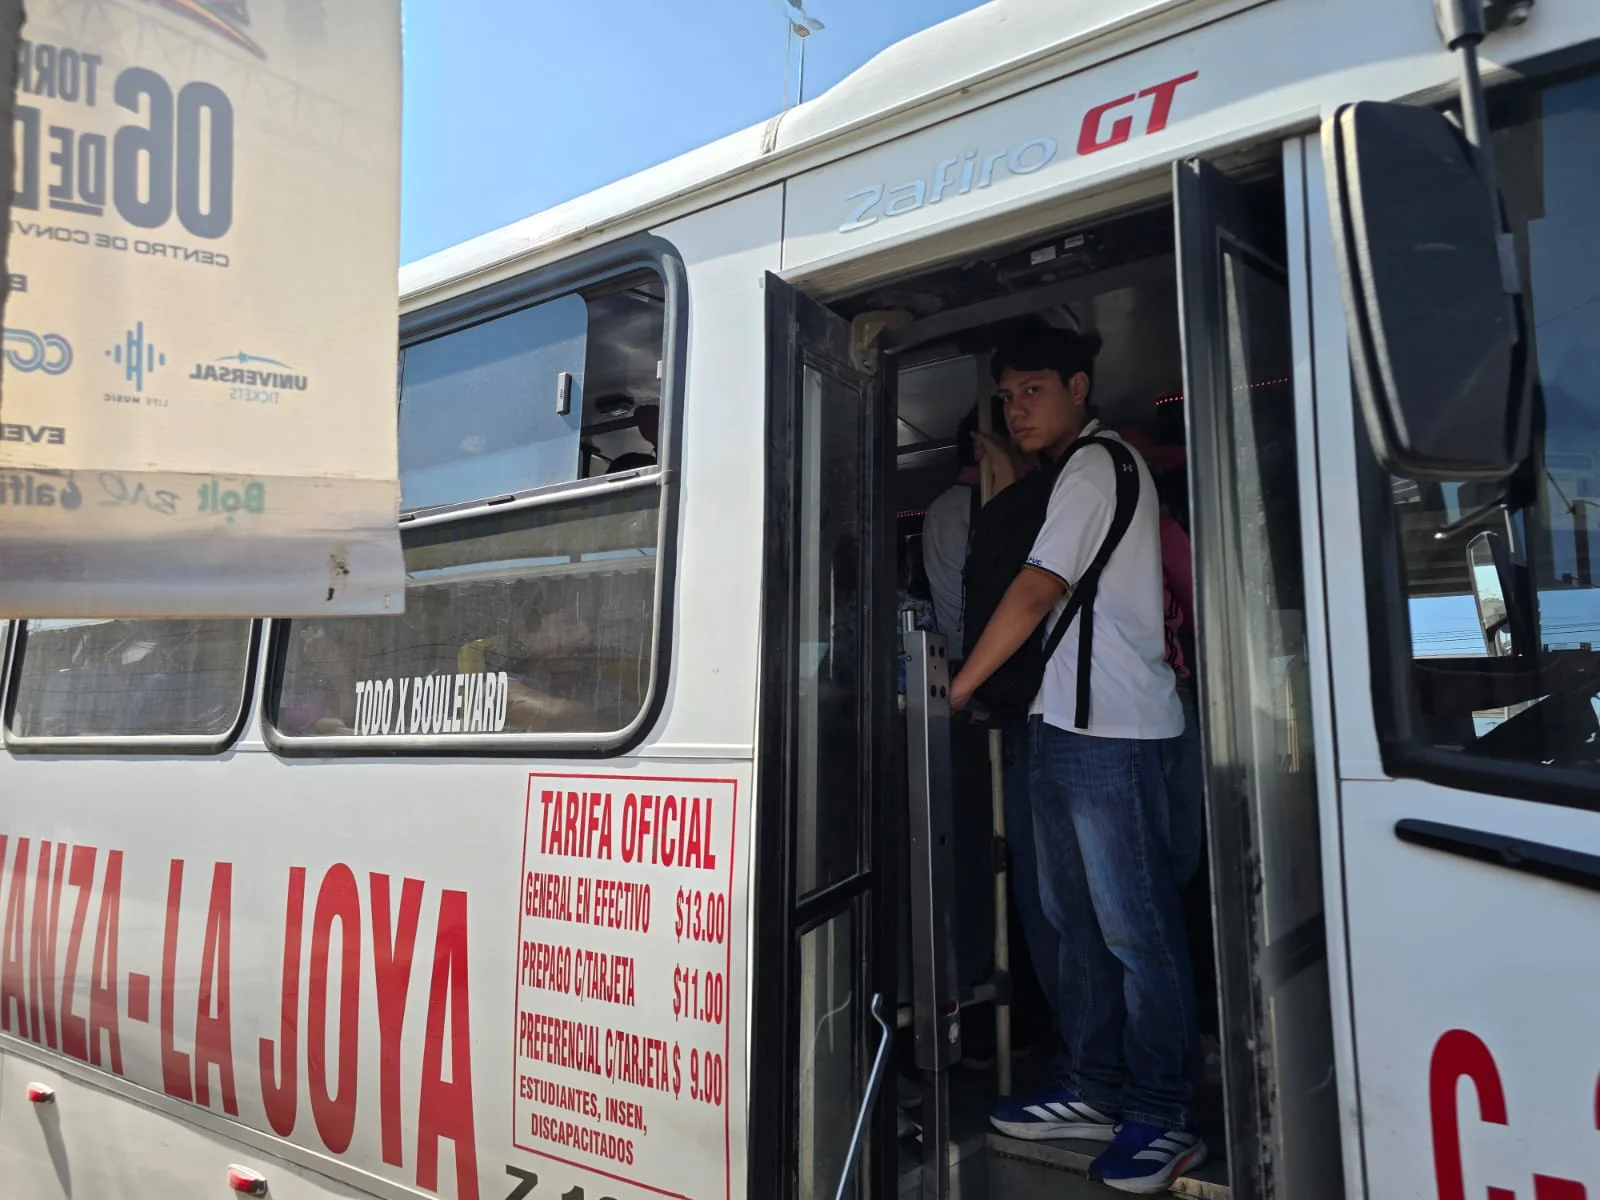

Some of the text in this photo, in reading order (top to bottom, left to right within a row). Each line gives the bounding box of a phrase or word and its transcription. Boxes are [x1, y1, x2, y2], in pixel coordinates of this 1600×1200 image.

[1077, 70, 1199, 156] GT
[354, 671, 508, 736] TODO X BOULEVARD
[540, 790, 716, 870] TARIFA OFICIAL
[525, 871, 725, 944] GENERAL EN EFECTIVO $13.00
[0, 834, 480, 1200] ANZA-LA JOYA
[521, 940, 724, 1025] PREPAGO C/TARJETA $11.00
[519, 1010, 602, 1076] PREFERENCIAL
[605, 1028, 670, 1093] C/TARJETA
[520, 1074, 648, 1136] ESTUDIANTES, INSEN,
[531, 1112, 634, 1166] DISCAPACITADOS
